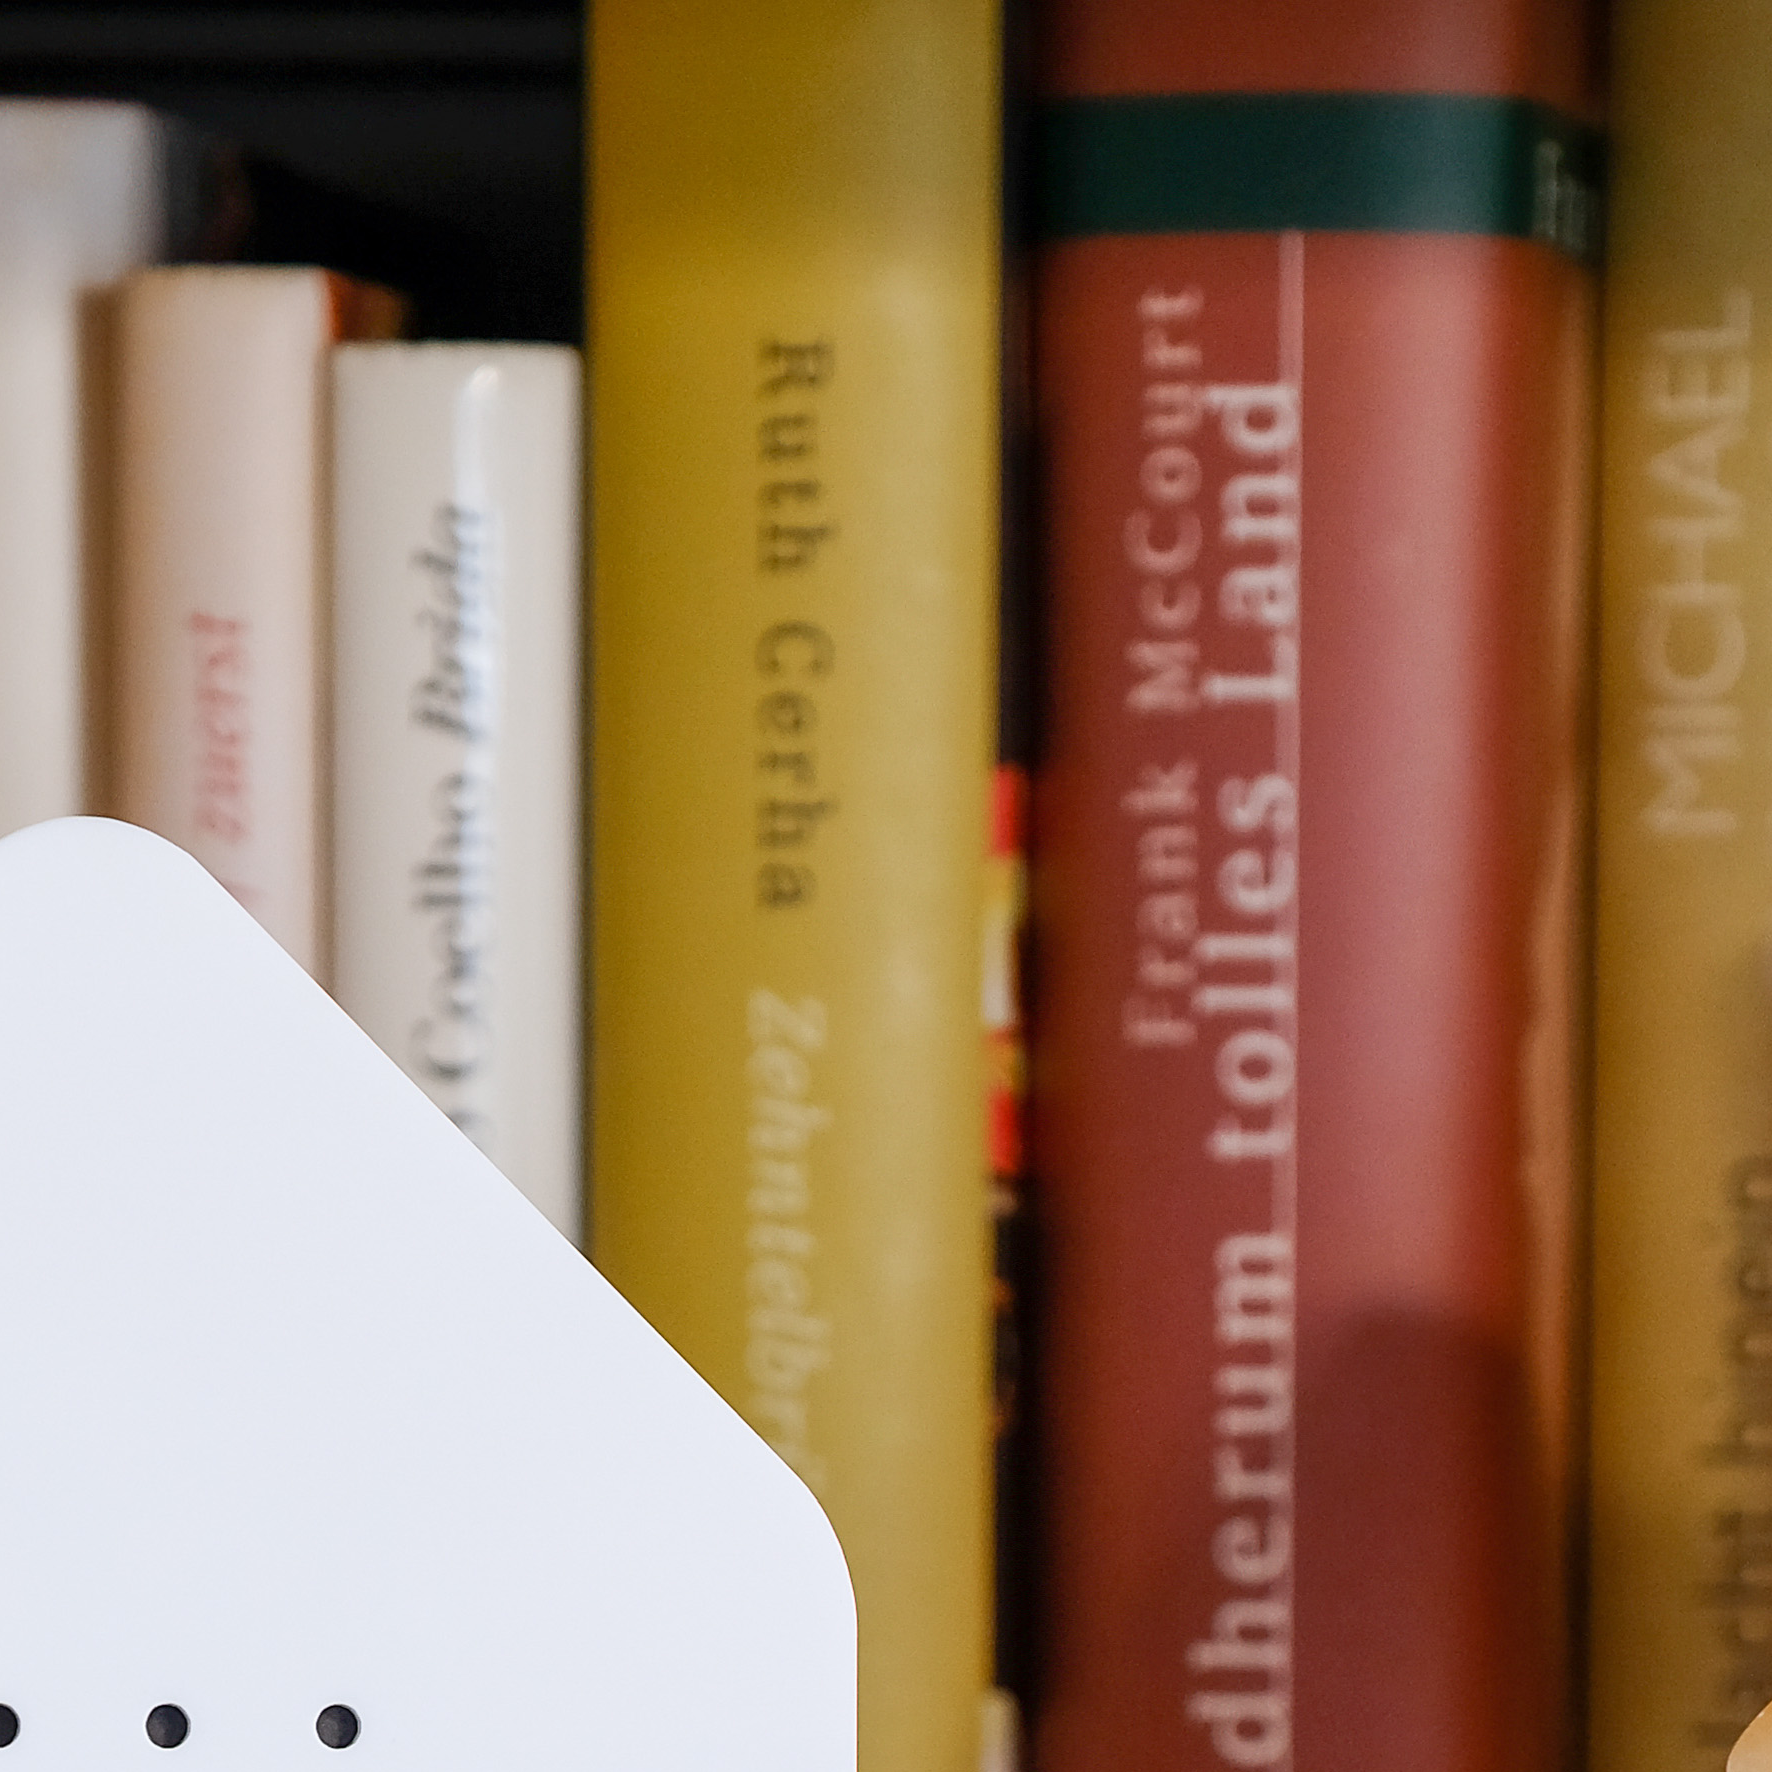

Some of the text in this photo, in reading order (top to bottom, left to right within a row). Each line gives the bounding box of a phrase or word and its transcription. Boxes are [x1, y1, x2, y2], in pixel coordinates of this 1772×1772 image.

[756, 336, 839, 576] Ruth
[1202, 380, 1302, 706] Land
[1642, 287, 1752, 839] MICHAEL
[754, 620, 839, 912] Cerha
[1123, 285, 1203, 1050] Frank McCourt
[1195, 772, 1300, 1164] tolles
